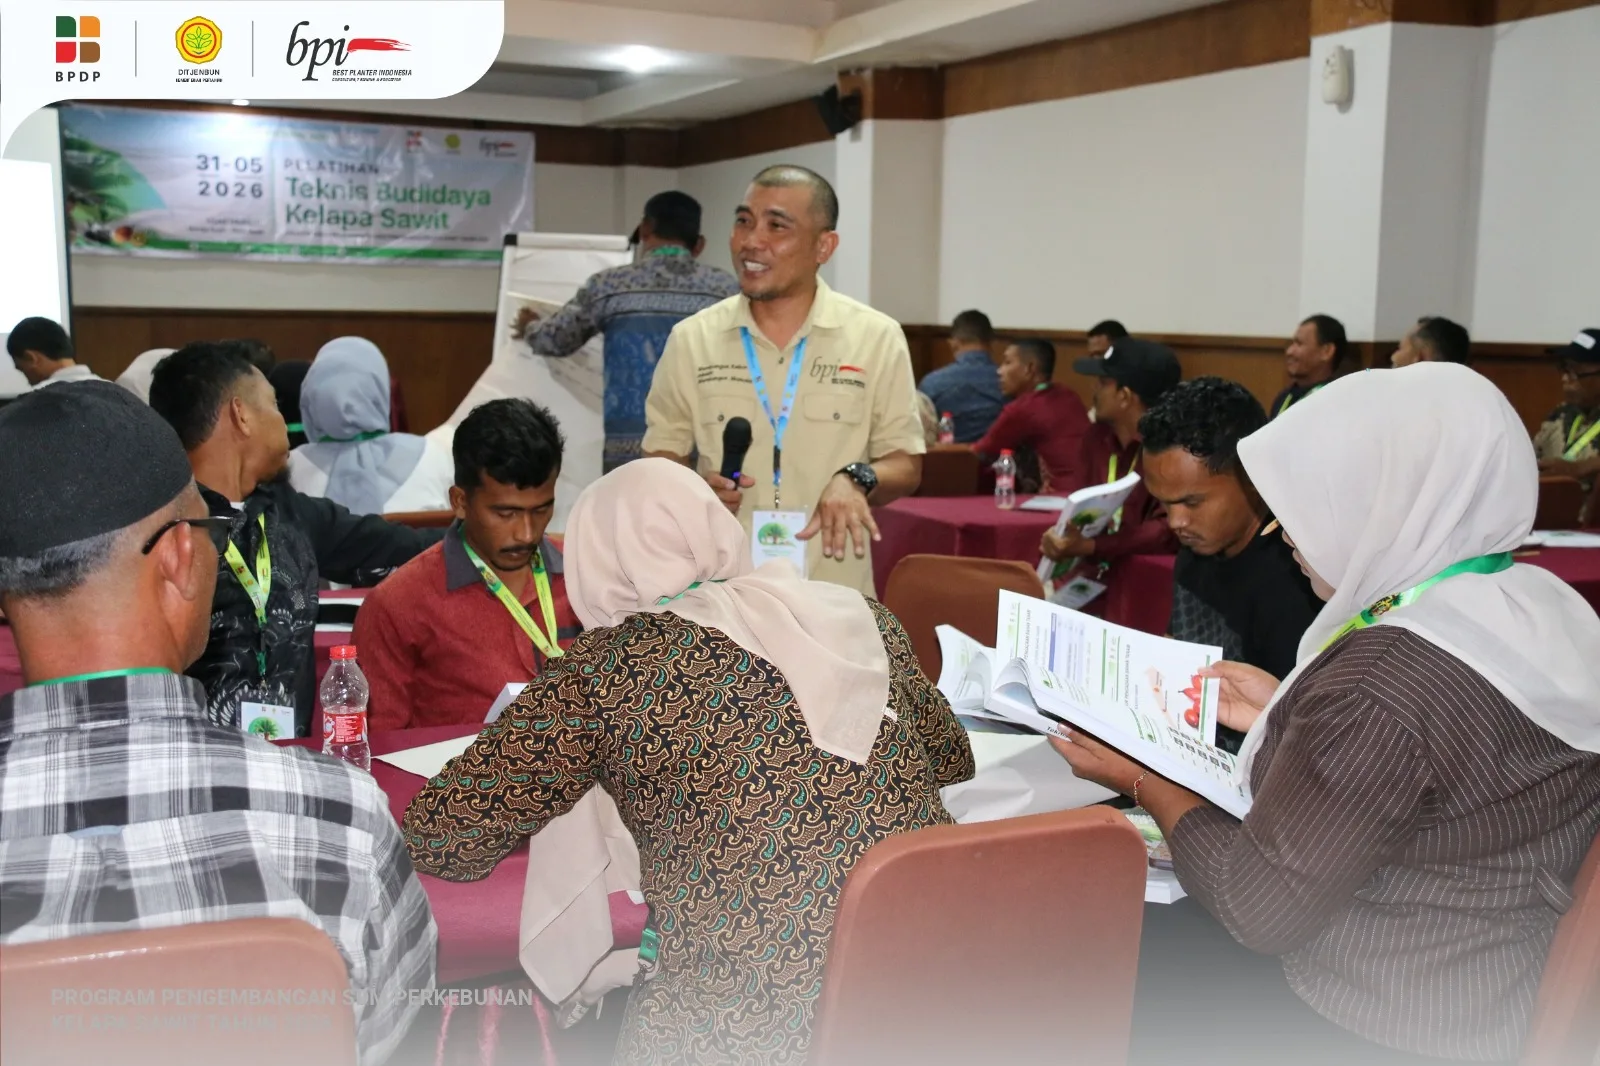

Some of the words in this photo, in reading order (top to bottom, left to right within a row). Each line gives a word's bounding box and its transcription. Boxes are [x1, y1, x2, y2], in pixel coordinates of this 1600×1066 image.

[198, 181, 263, 198] 2026
[284, 176, 369, 200] Teknis
[377, 181, 492, 211] Budidaya
[286, 204, 373, 231] Kelapa
[381, 207, 450, 229] Sawit
[809, 356, 841, 385] bpi
